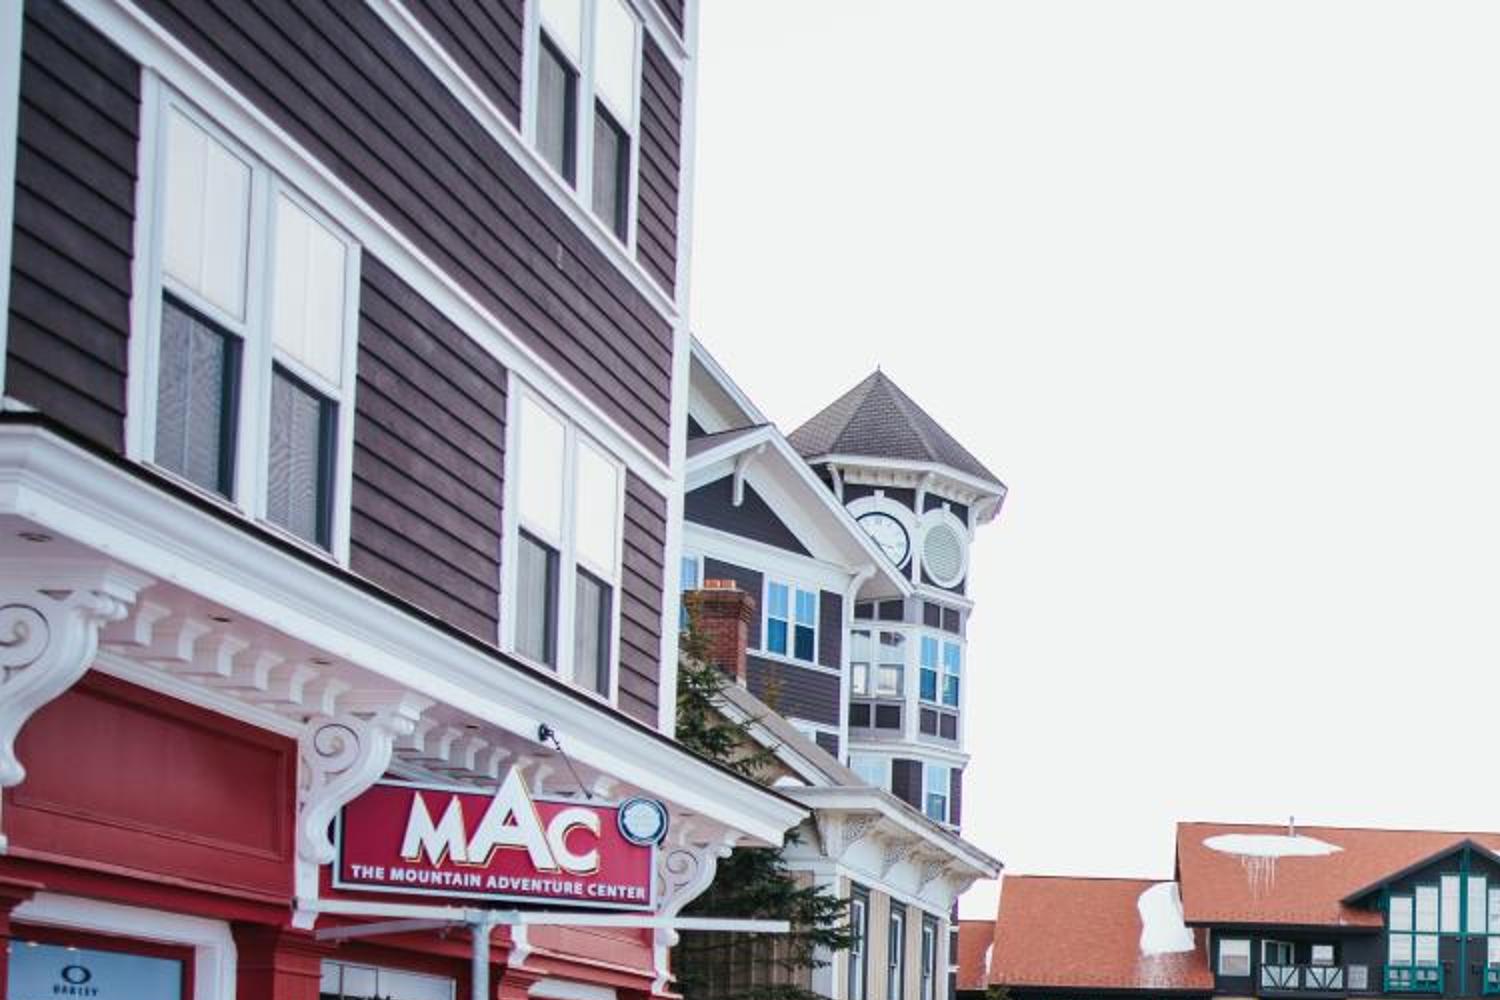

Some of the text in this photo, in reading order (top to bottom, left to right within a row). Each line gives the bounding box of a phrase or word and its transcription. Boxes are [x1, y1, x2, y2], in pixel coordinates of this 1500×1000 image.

[400, 764, 601, 876] MAC
[351, 864, 646, 900] THE MOUNTAIN ADVENTURE CENTER
